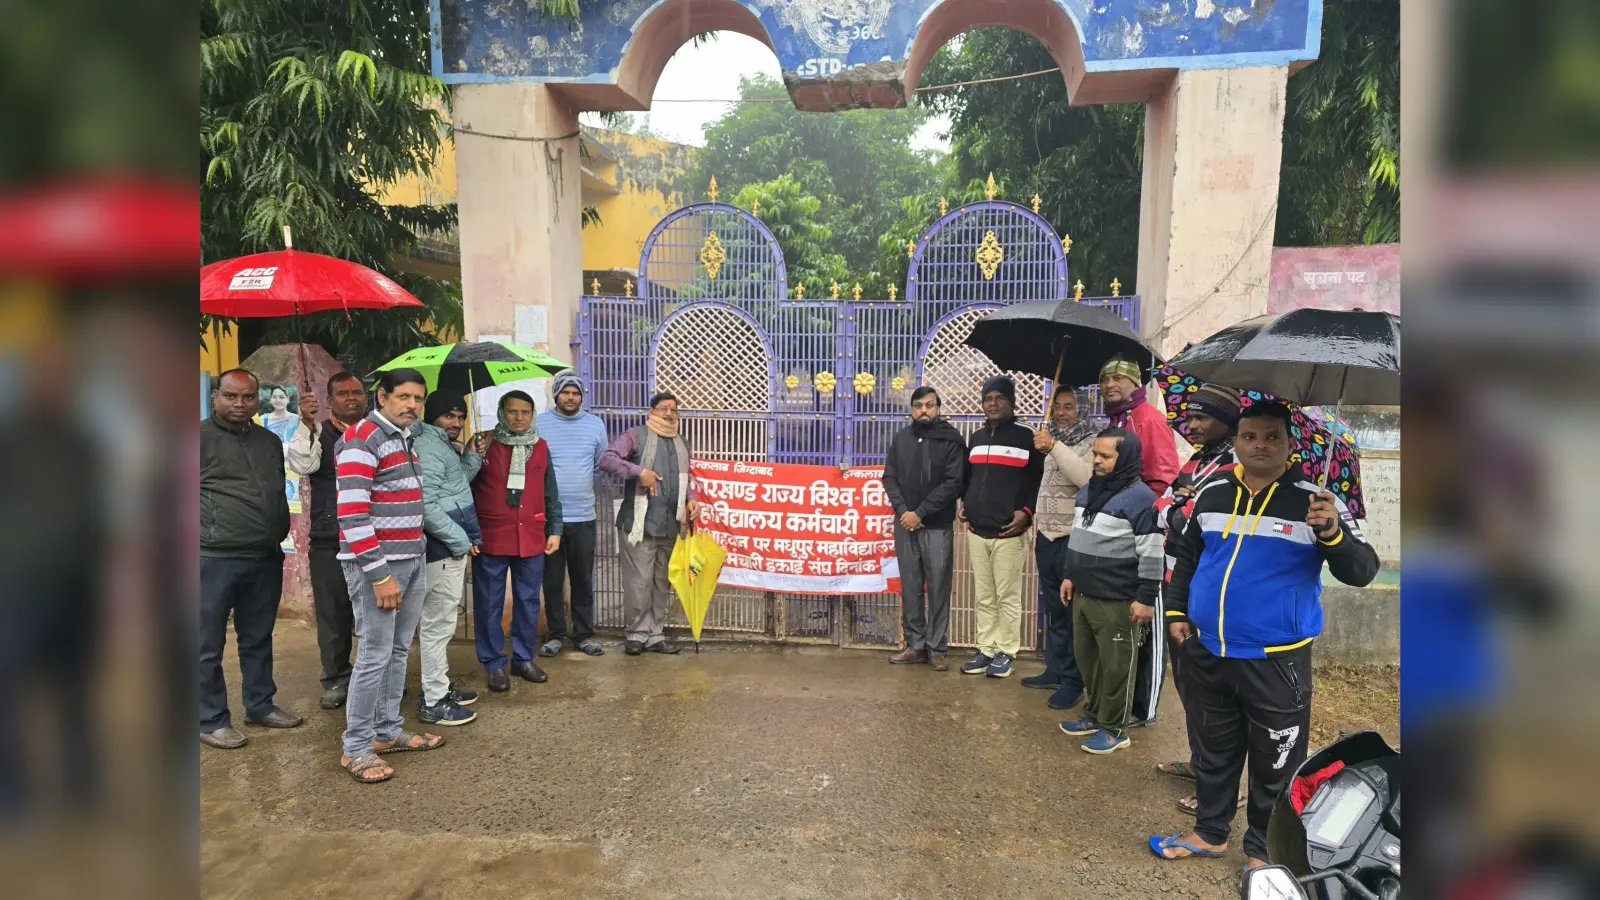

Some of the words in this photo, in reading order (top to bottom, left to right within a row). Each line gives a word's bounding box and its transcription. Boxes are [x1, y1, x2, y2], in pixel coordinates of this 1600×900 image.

[233, 266, 278, 277] ACC
[1303, 272, 1342, 290] सूचना
[690, 459, 729, 472] इन्कलाब
[734, 462, 773, 477] जिन्दाबाद
[761, 484, 806, 505] राज्य
[698, 501, 783, 531] हाविद्यालय
[786, 508, 860, 534] कर्मचारी
[753, 537, 771, 552] पर
[773, 538, 815, 559] मधुपुर
[808, 558, 832, 575] संघ
